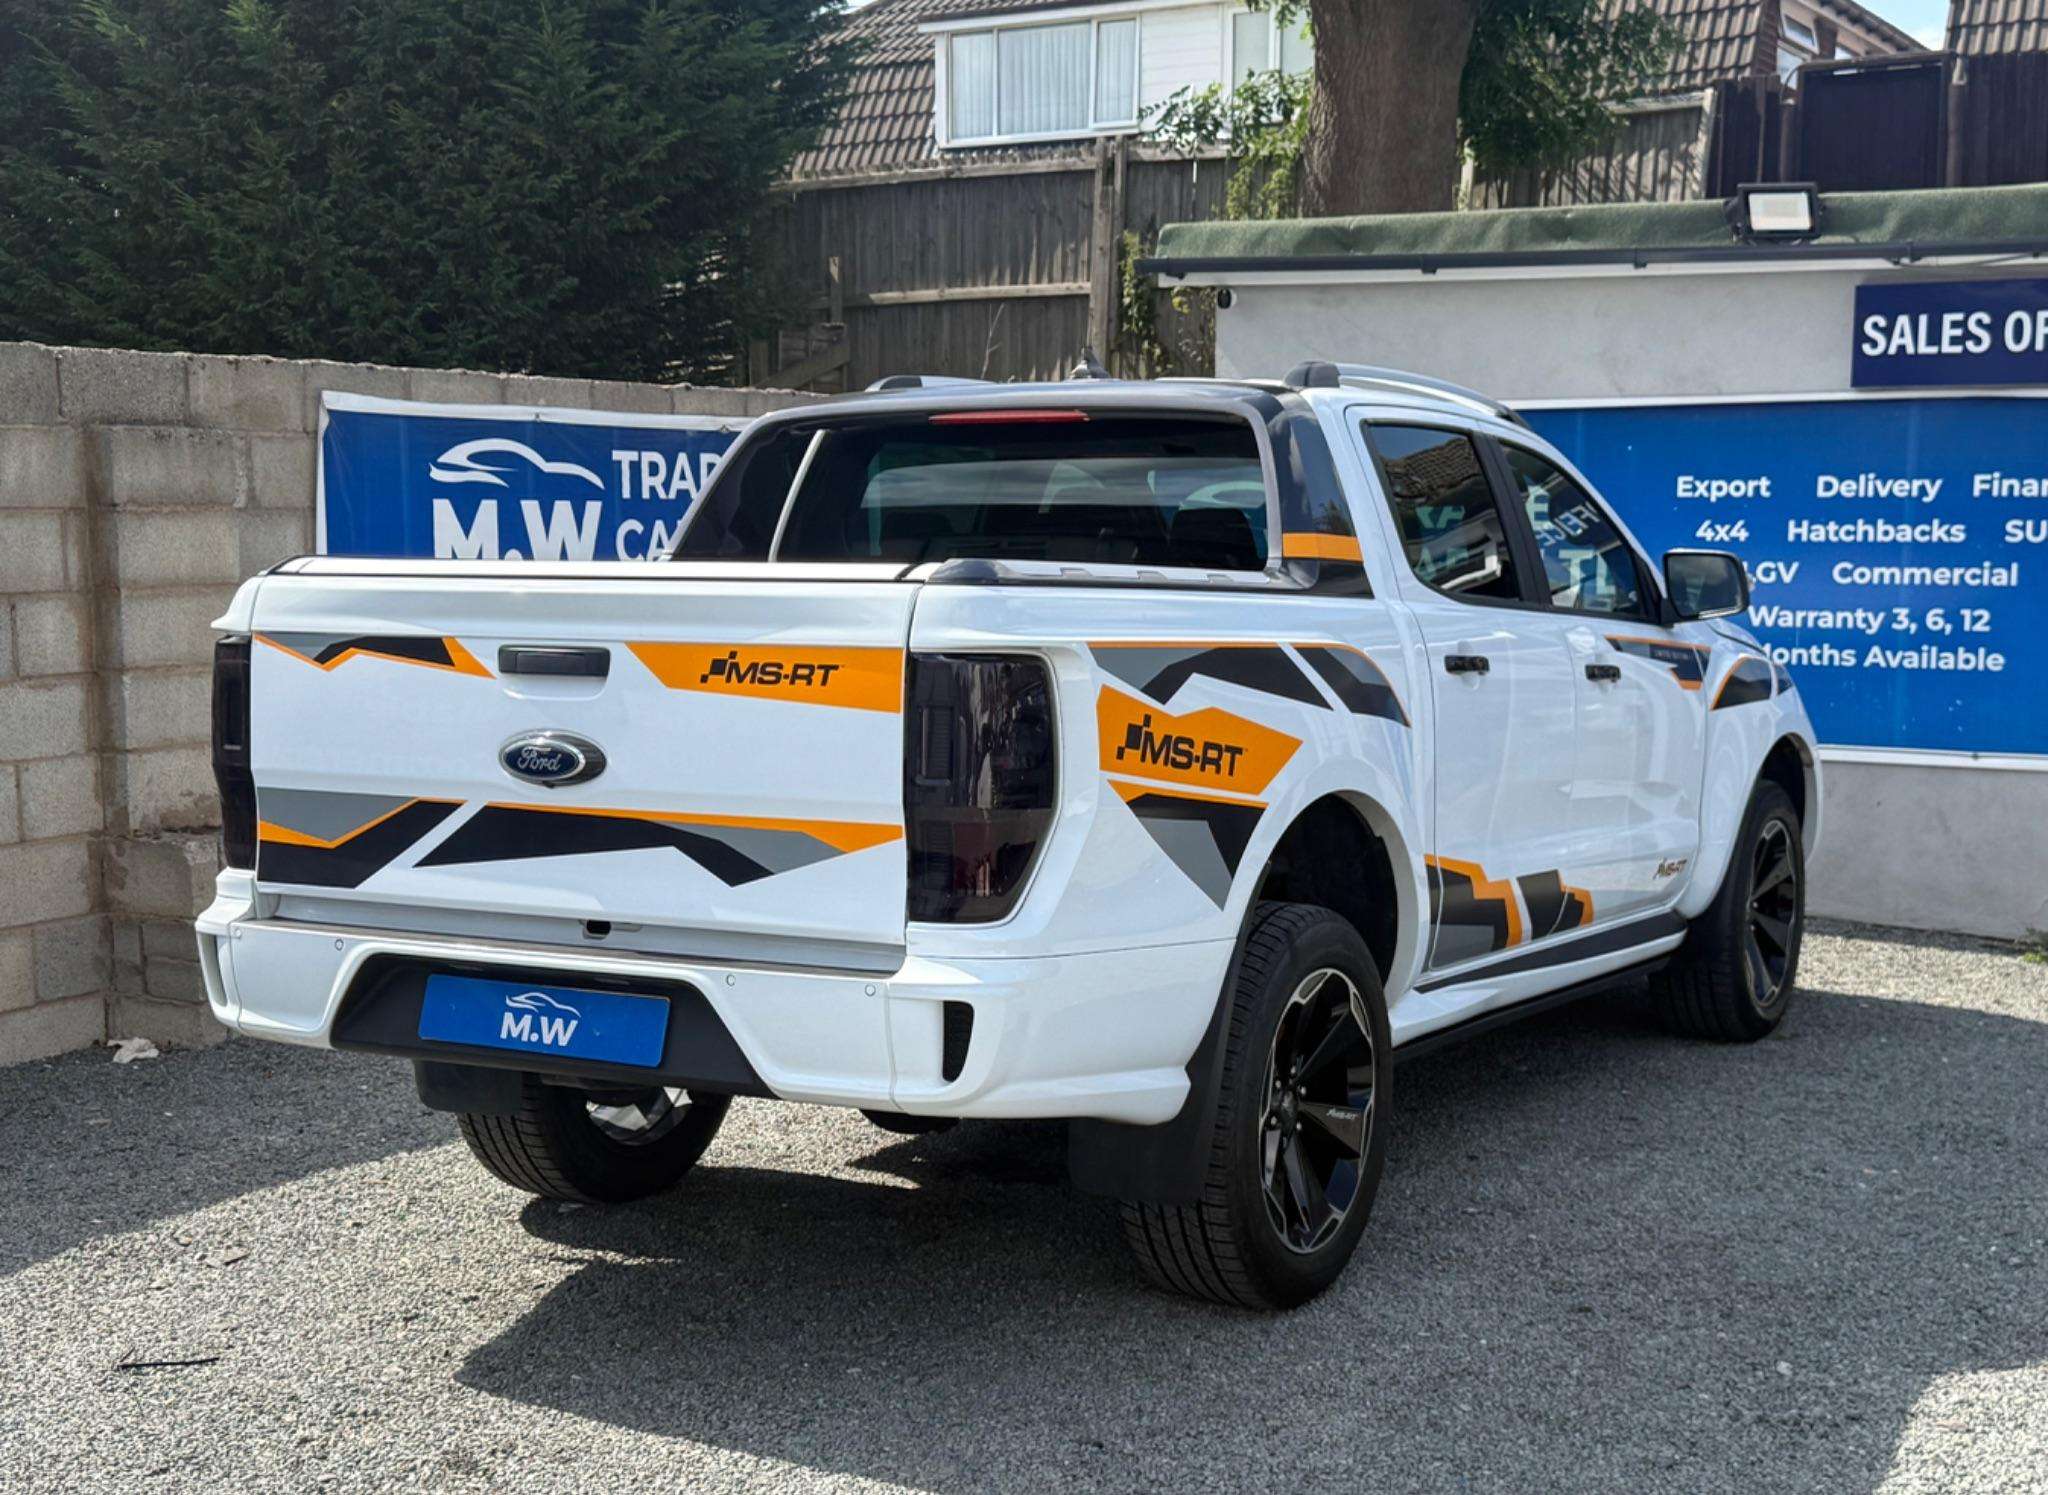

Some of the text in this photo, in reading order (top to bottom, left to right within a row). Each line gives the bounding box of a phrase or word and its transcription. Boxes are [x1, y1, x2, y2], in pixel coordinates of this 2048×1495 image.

[1861, 311, 1993, 357] SALES
[1676, 475, 1771, 503] Export
[1816, 472, 1943, 503] Delivery
[432, 498, 602, 561] M.W
[1695, 519, 1749, 542] 4x4
[1787, 518, 1967, 543] Hatchbacks
[1744, 561, 2018, 587] GV Commercial
[1749, 606, 1991, 635] Warranty 3, 6, 12
[1863, 644, 2006, 671] Available
[517, 745, 562, 771] Ford
[500, 1012, 578, 1047] M.W
